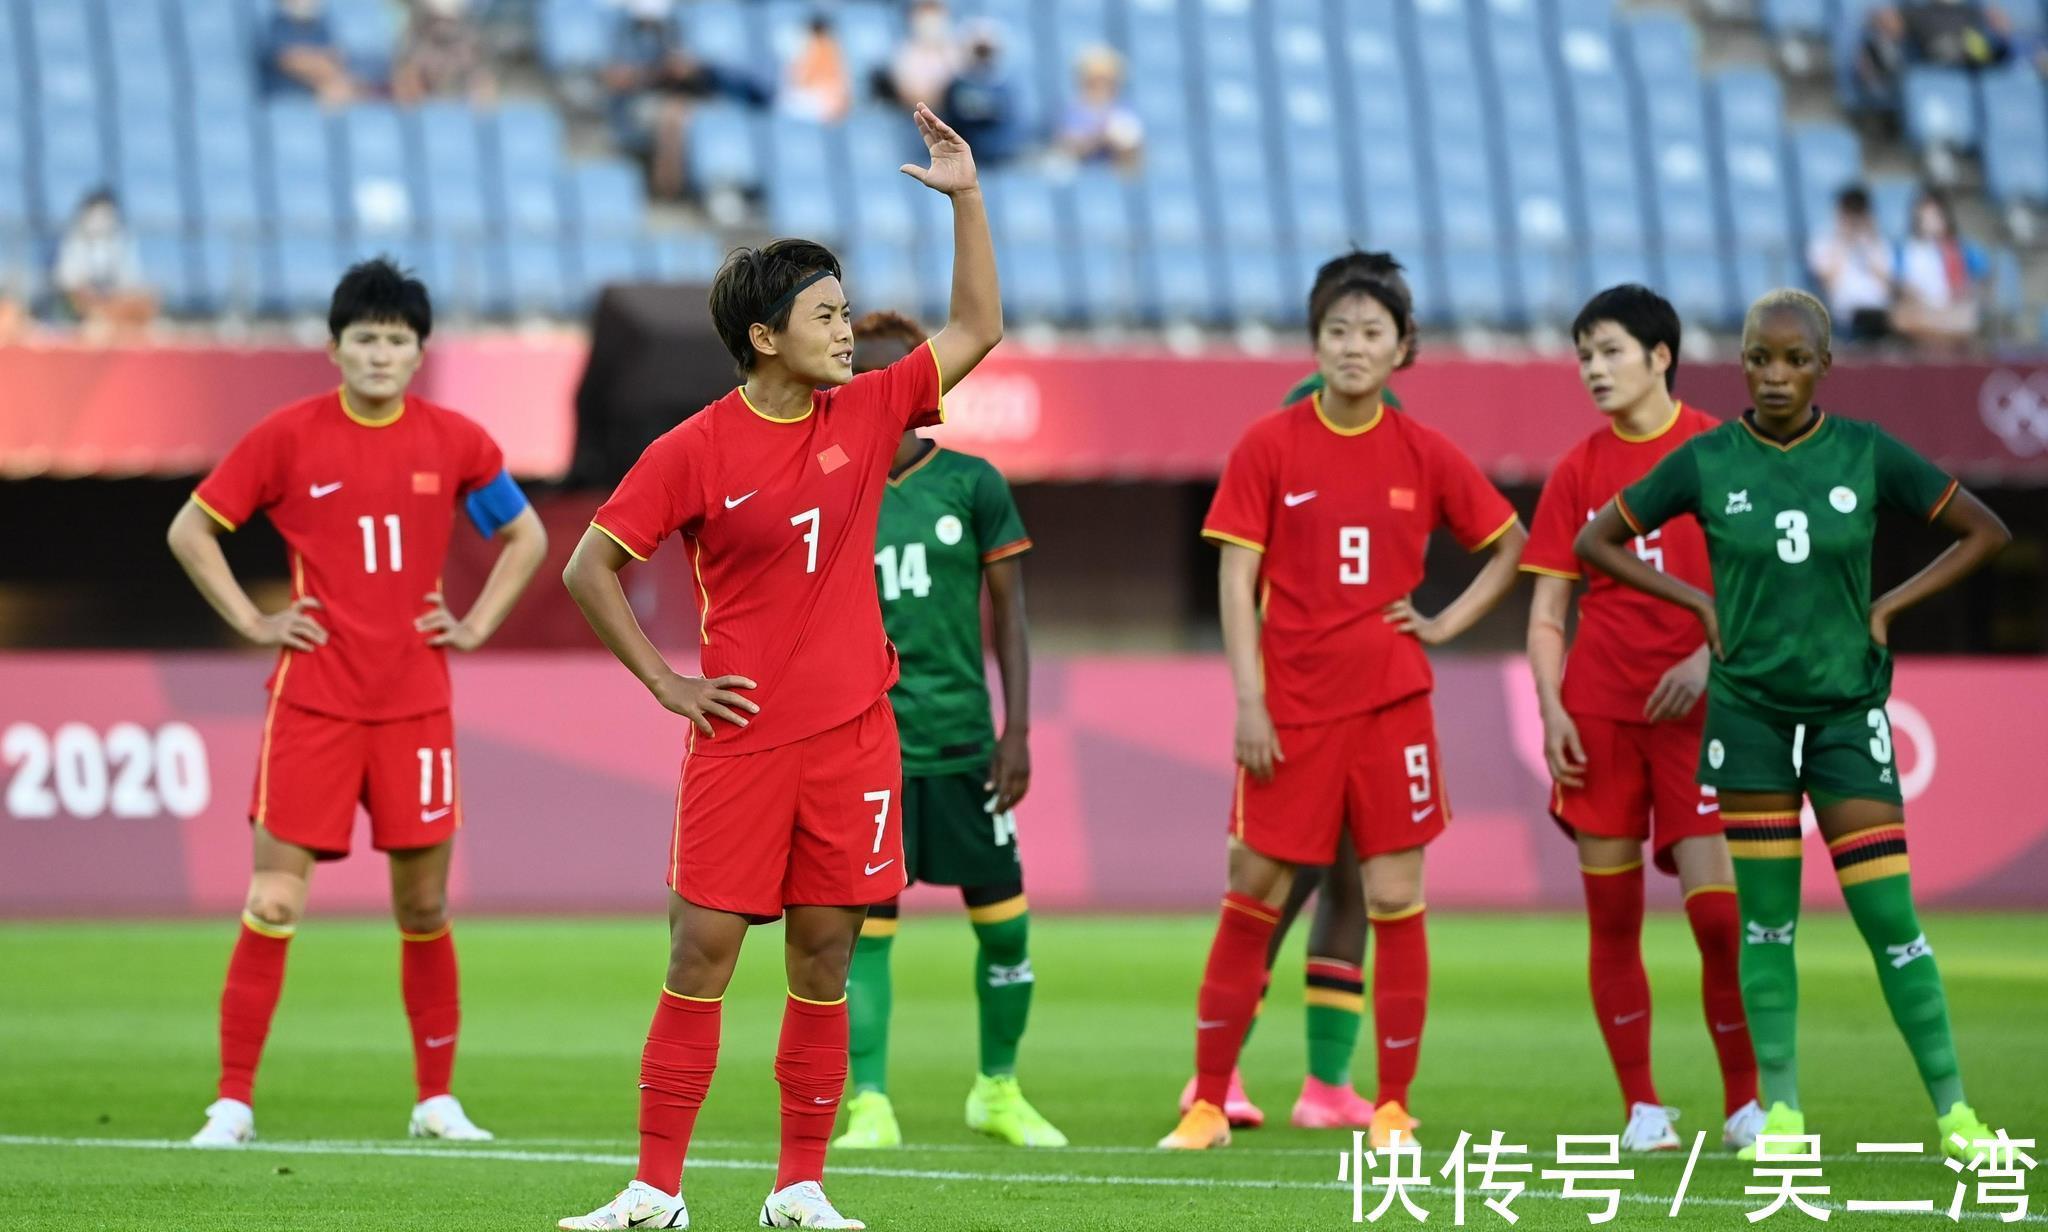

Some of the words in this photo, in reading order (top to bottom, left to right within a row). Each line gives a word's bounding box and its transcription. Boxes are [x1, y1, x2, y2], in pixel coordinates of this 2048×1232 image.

[357, 514, 402, 574] 11
[790, 507, 820, 574] 7
[1339, 526, 1370, 585] 9
[1775, 509, 1811, 564] 3
[874, 542, 932, 601] 14
[1867, 708, 1892, 764] 3
[2, 722, 211, 819] 2020
[416, 747, 453, 806] 11
[1404, 744, 1431, 802] 9
[863, 789, 891, 854] 7
